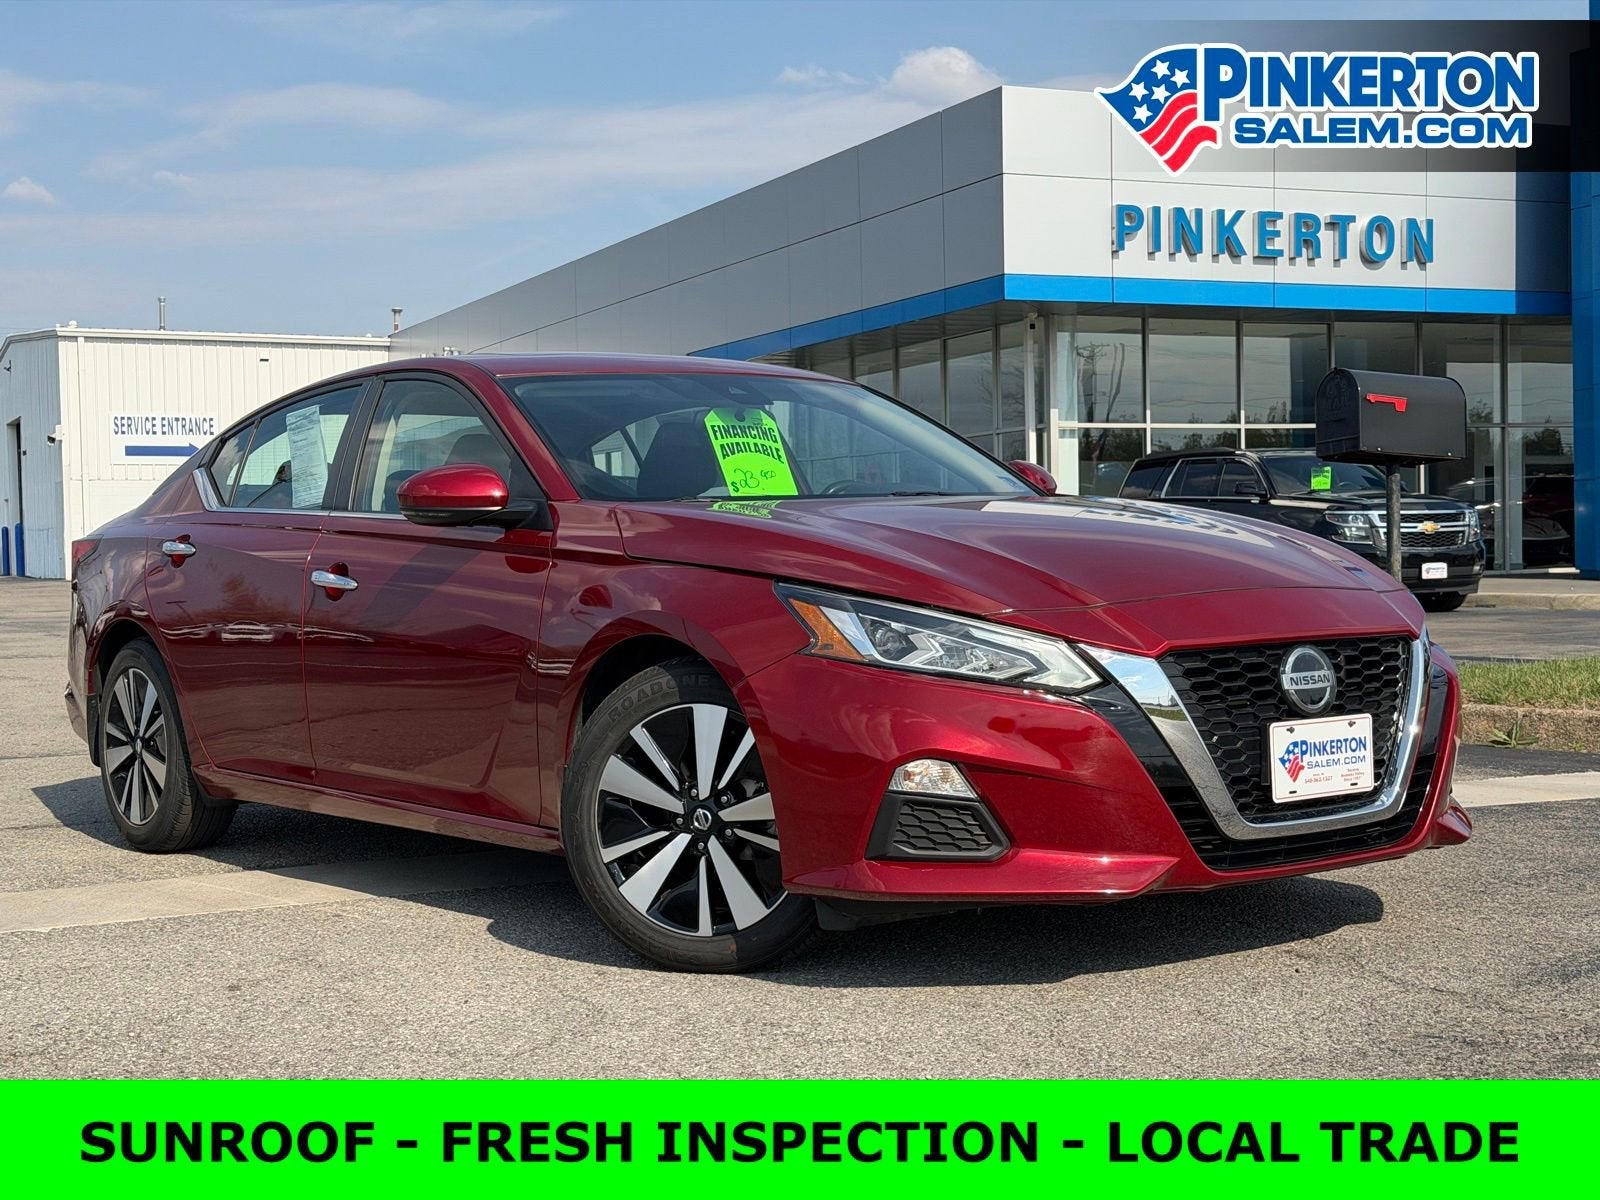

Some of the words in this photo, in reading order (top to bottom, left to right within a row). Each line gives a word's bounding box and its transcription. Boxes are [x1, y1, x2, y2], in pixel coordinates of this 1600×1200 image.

[1113, 203, 1435, 264] PINKERTON
[113, 415, 158, 436] SERVICE
[161, 416, 215, 436] ENTRANCE
[709, 424, 779, 444] FINANCING
[719, 441, 785, 464] AVAILABLE
[1289, 673, 1331, 687] NISSAN
[1299, 736, 1367, 763] PINKERTON
[1306, 754, 1367, 770] SALEM.COM
